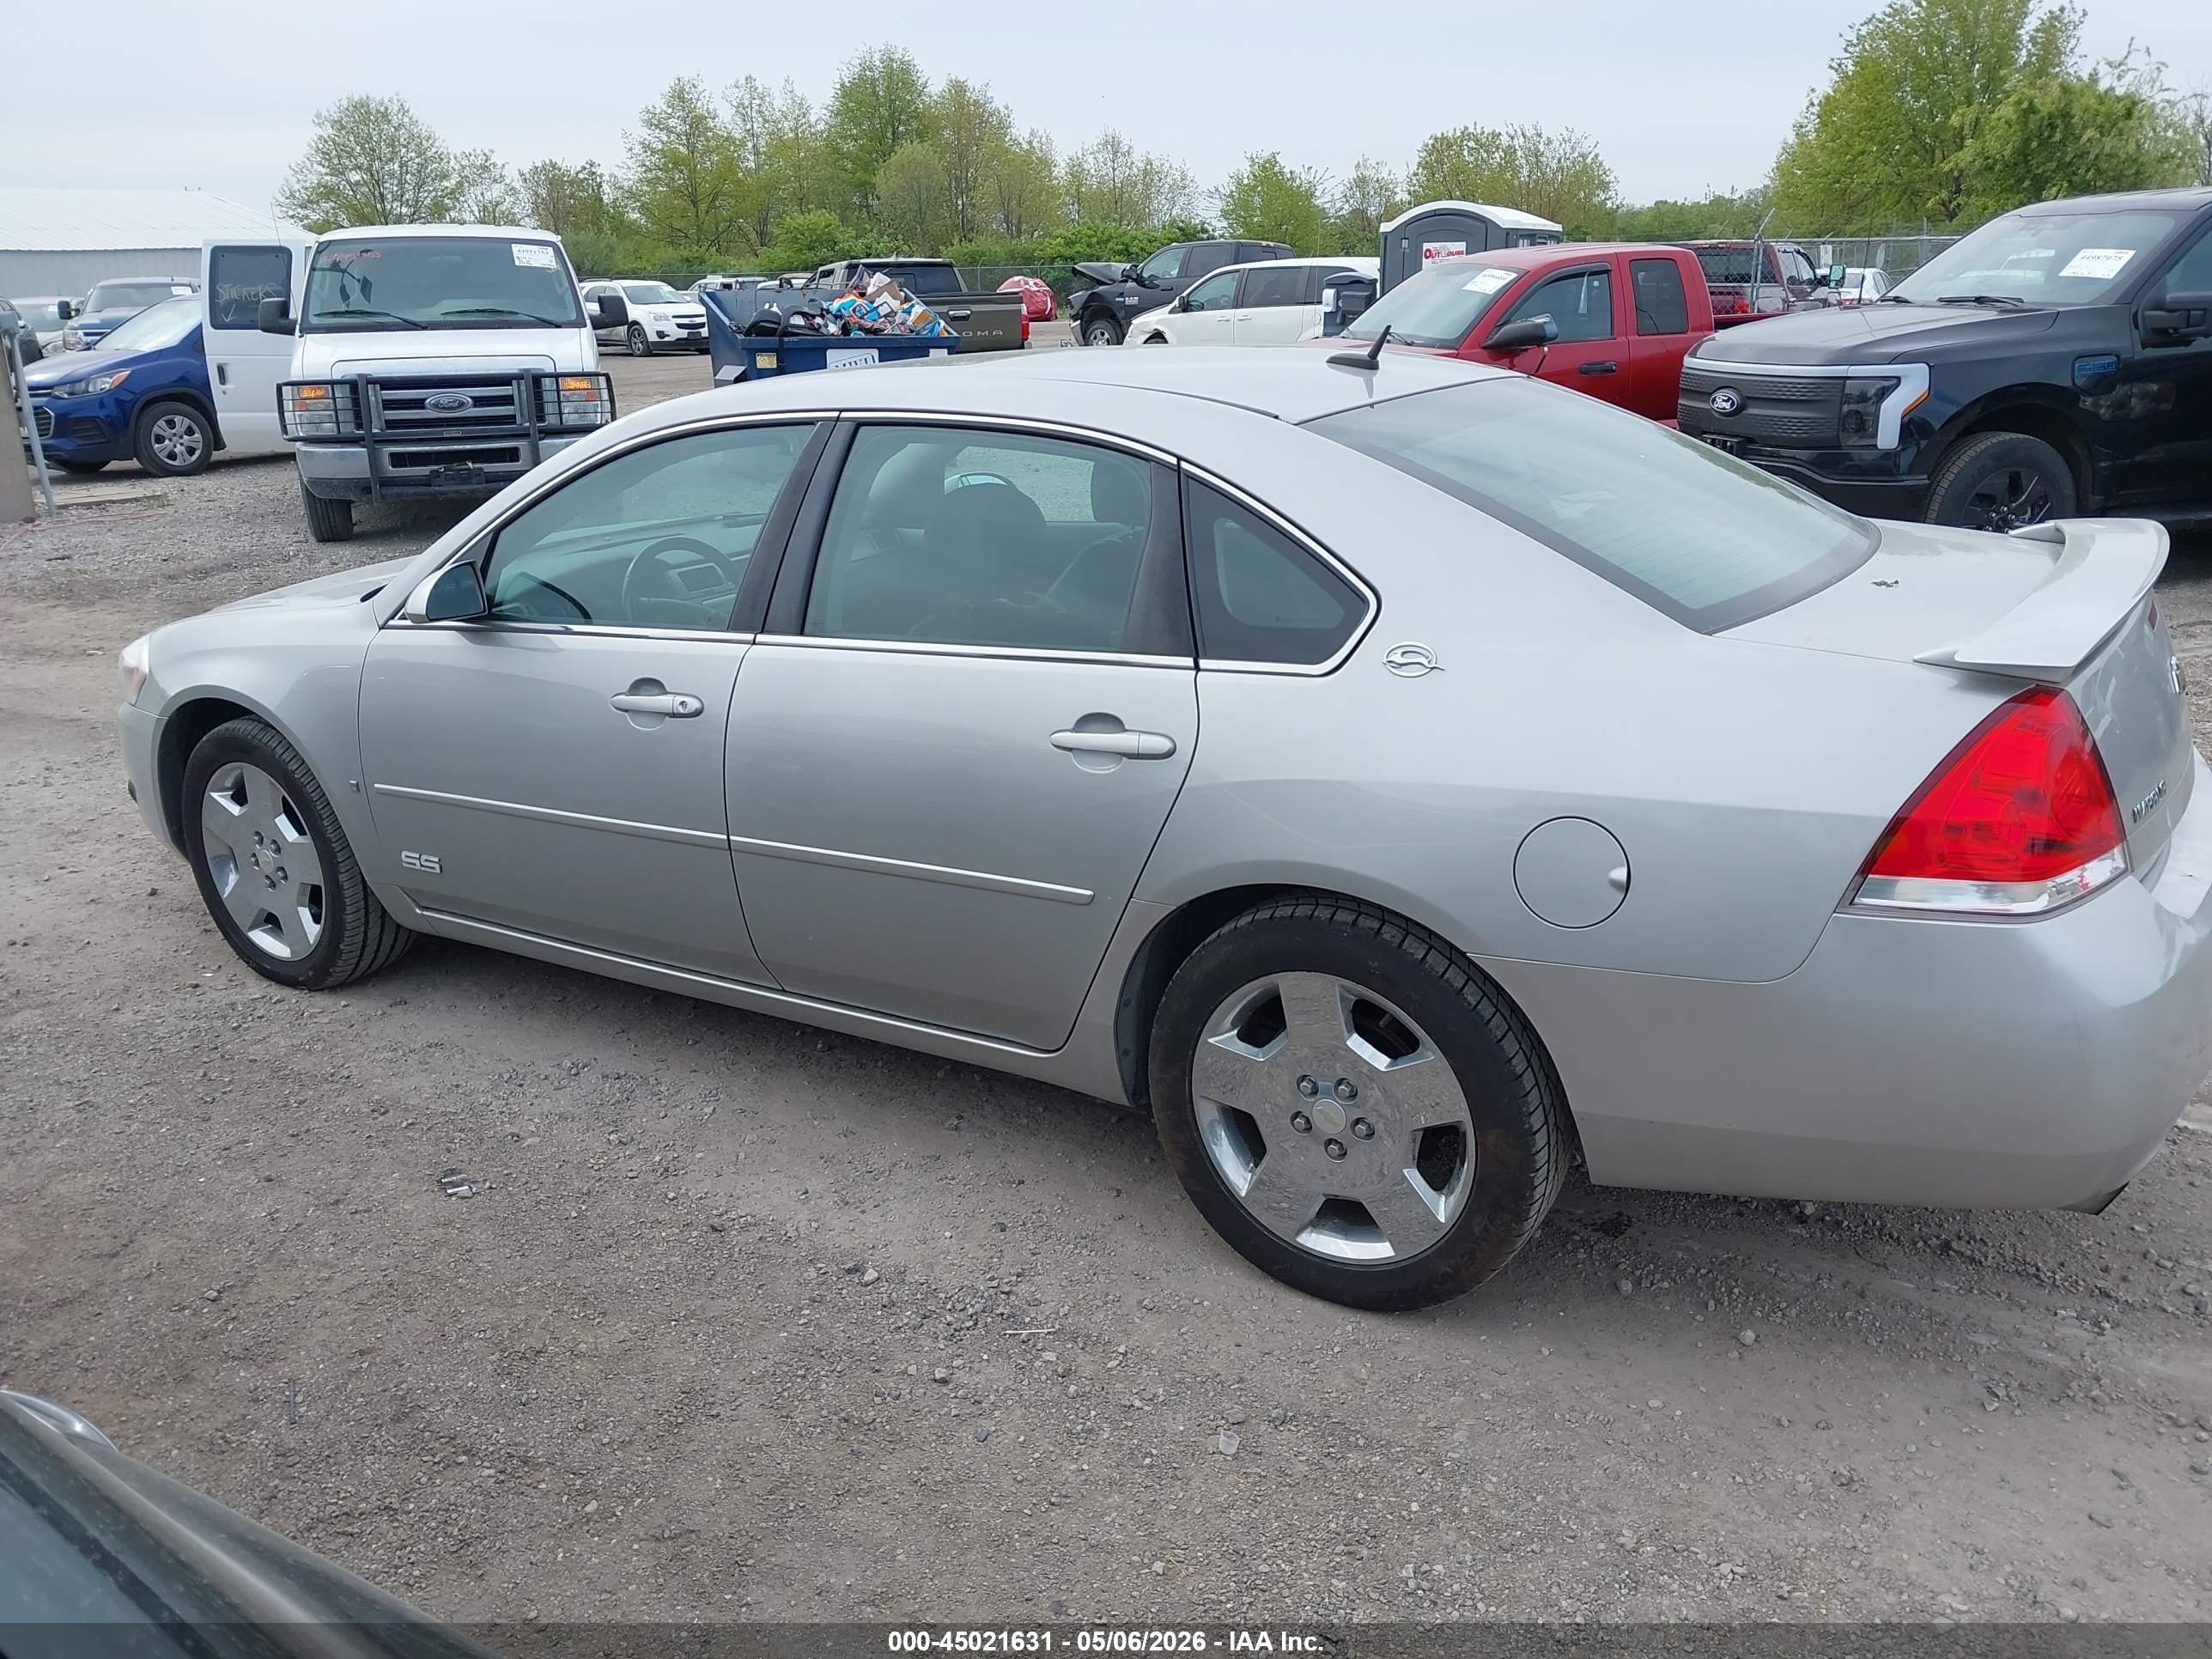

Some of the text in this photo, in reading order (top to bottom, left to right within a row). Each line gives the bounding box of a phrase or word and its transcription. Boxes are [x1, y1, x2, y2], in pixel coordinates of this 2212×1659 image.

[214, 283, 277, 302] STICKERS
[1714, 395, 1733, 410] Ford
[401, 850, 442, 873] SS
